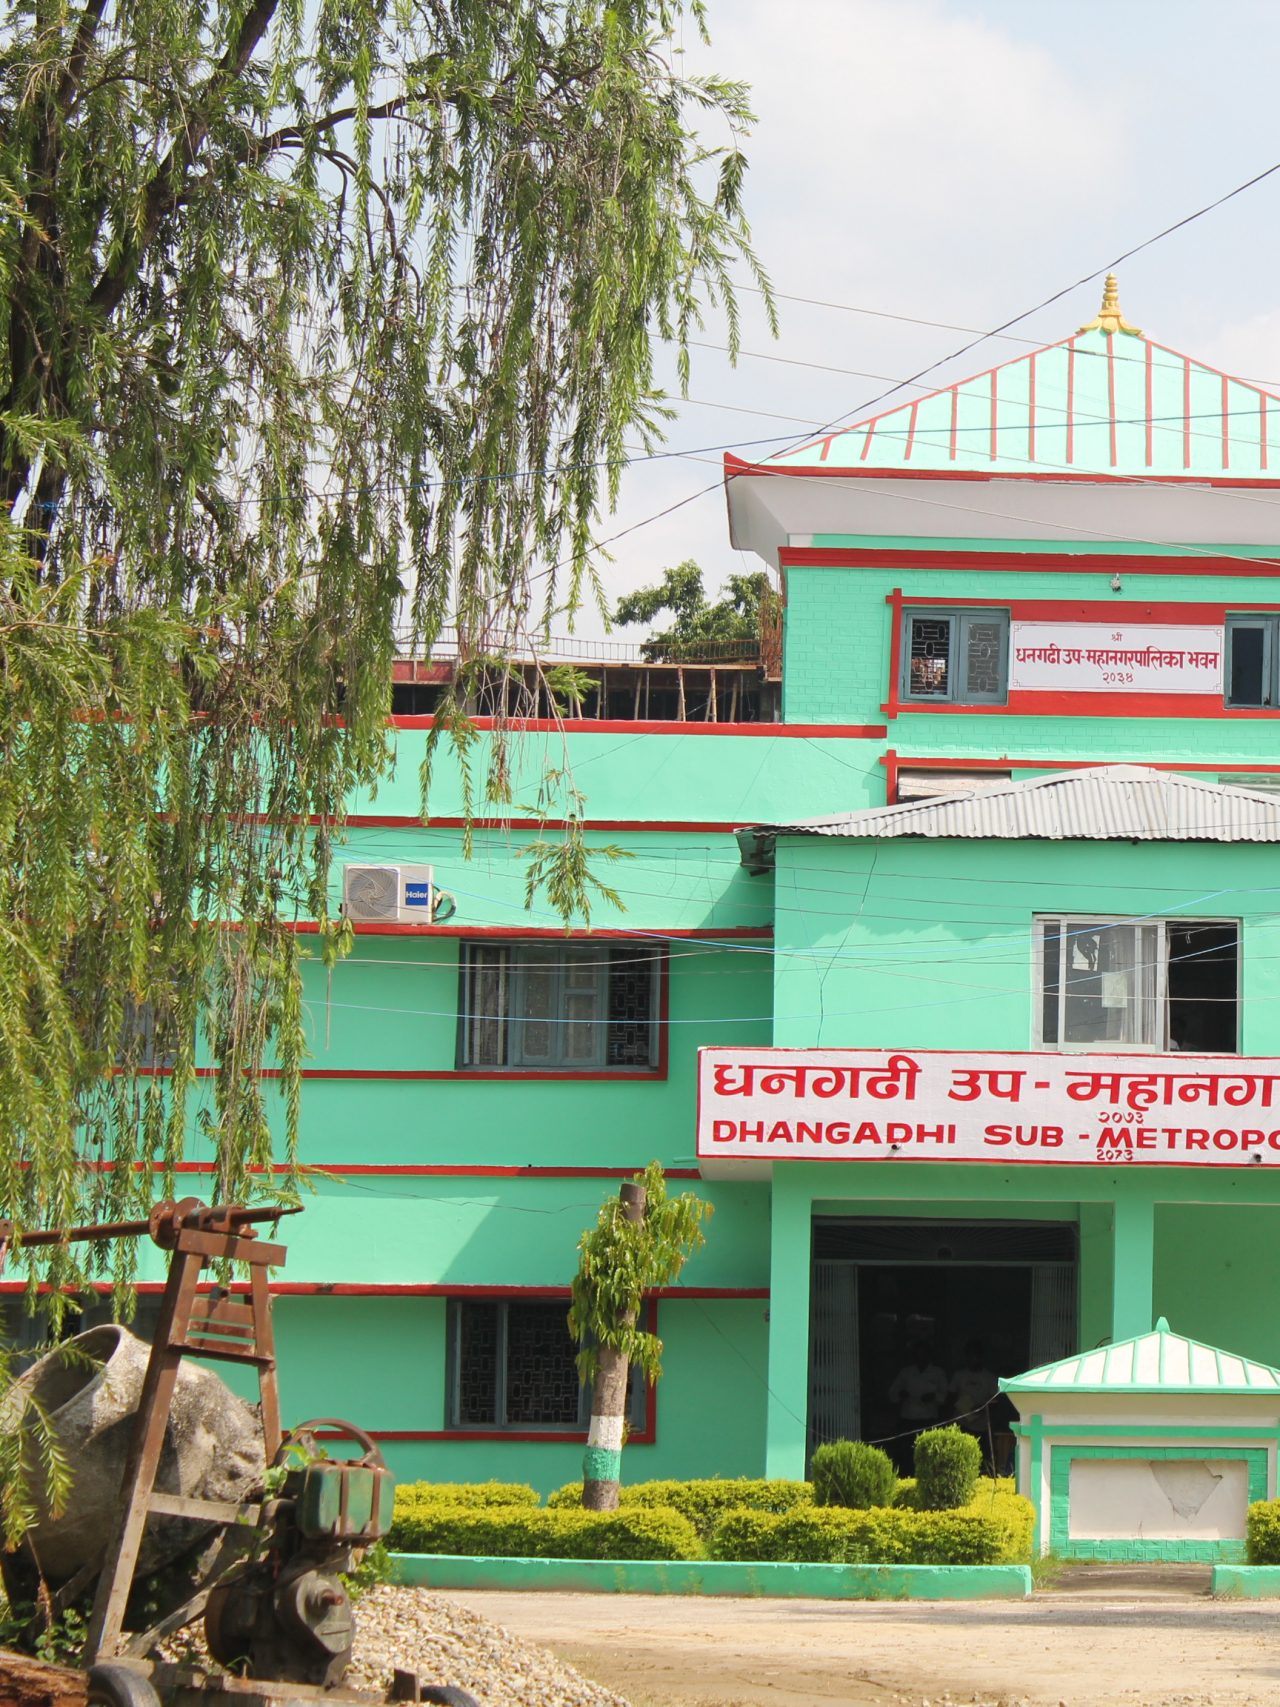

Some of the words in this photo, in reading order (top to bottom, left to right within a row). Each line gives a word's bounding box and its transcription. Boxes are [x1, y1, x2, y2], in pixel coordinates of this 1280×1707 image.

[1016, 643, 1061, 665] धनगढी
[1187, 651, 1220, 669] भवन
[1102, 672, 1134, 685] २०३४
[406, 891, 428, 899] Haier
[713, 1054, 923, 1101] धनगढी
[712, 1120, 957, 1144] DHANGADHI
[1096, 1149, 1134, 1161] 2073
